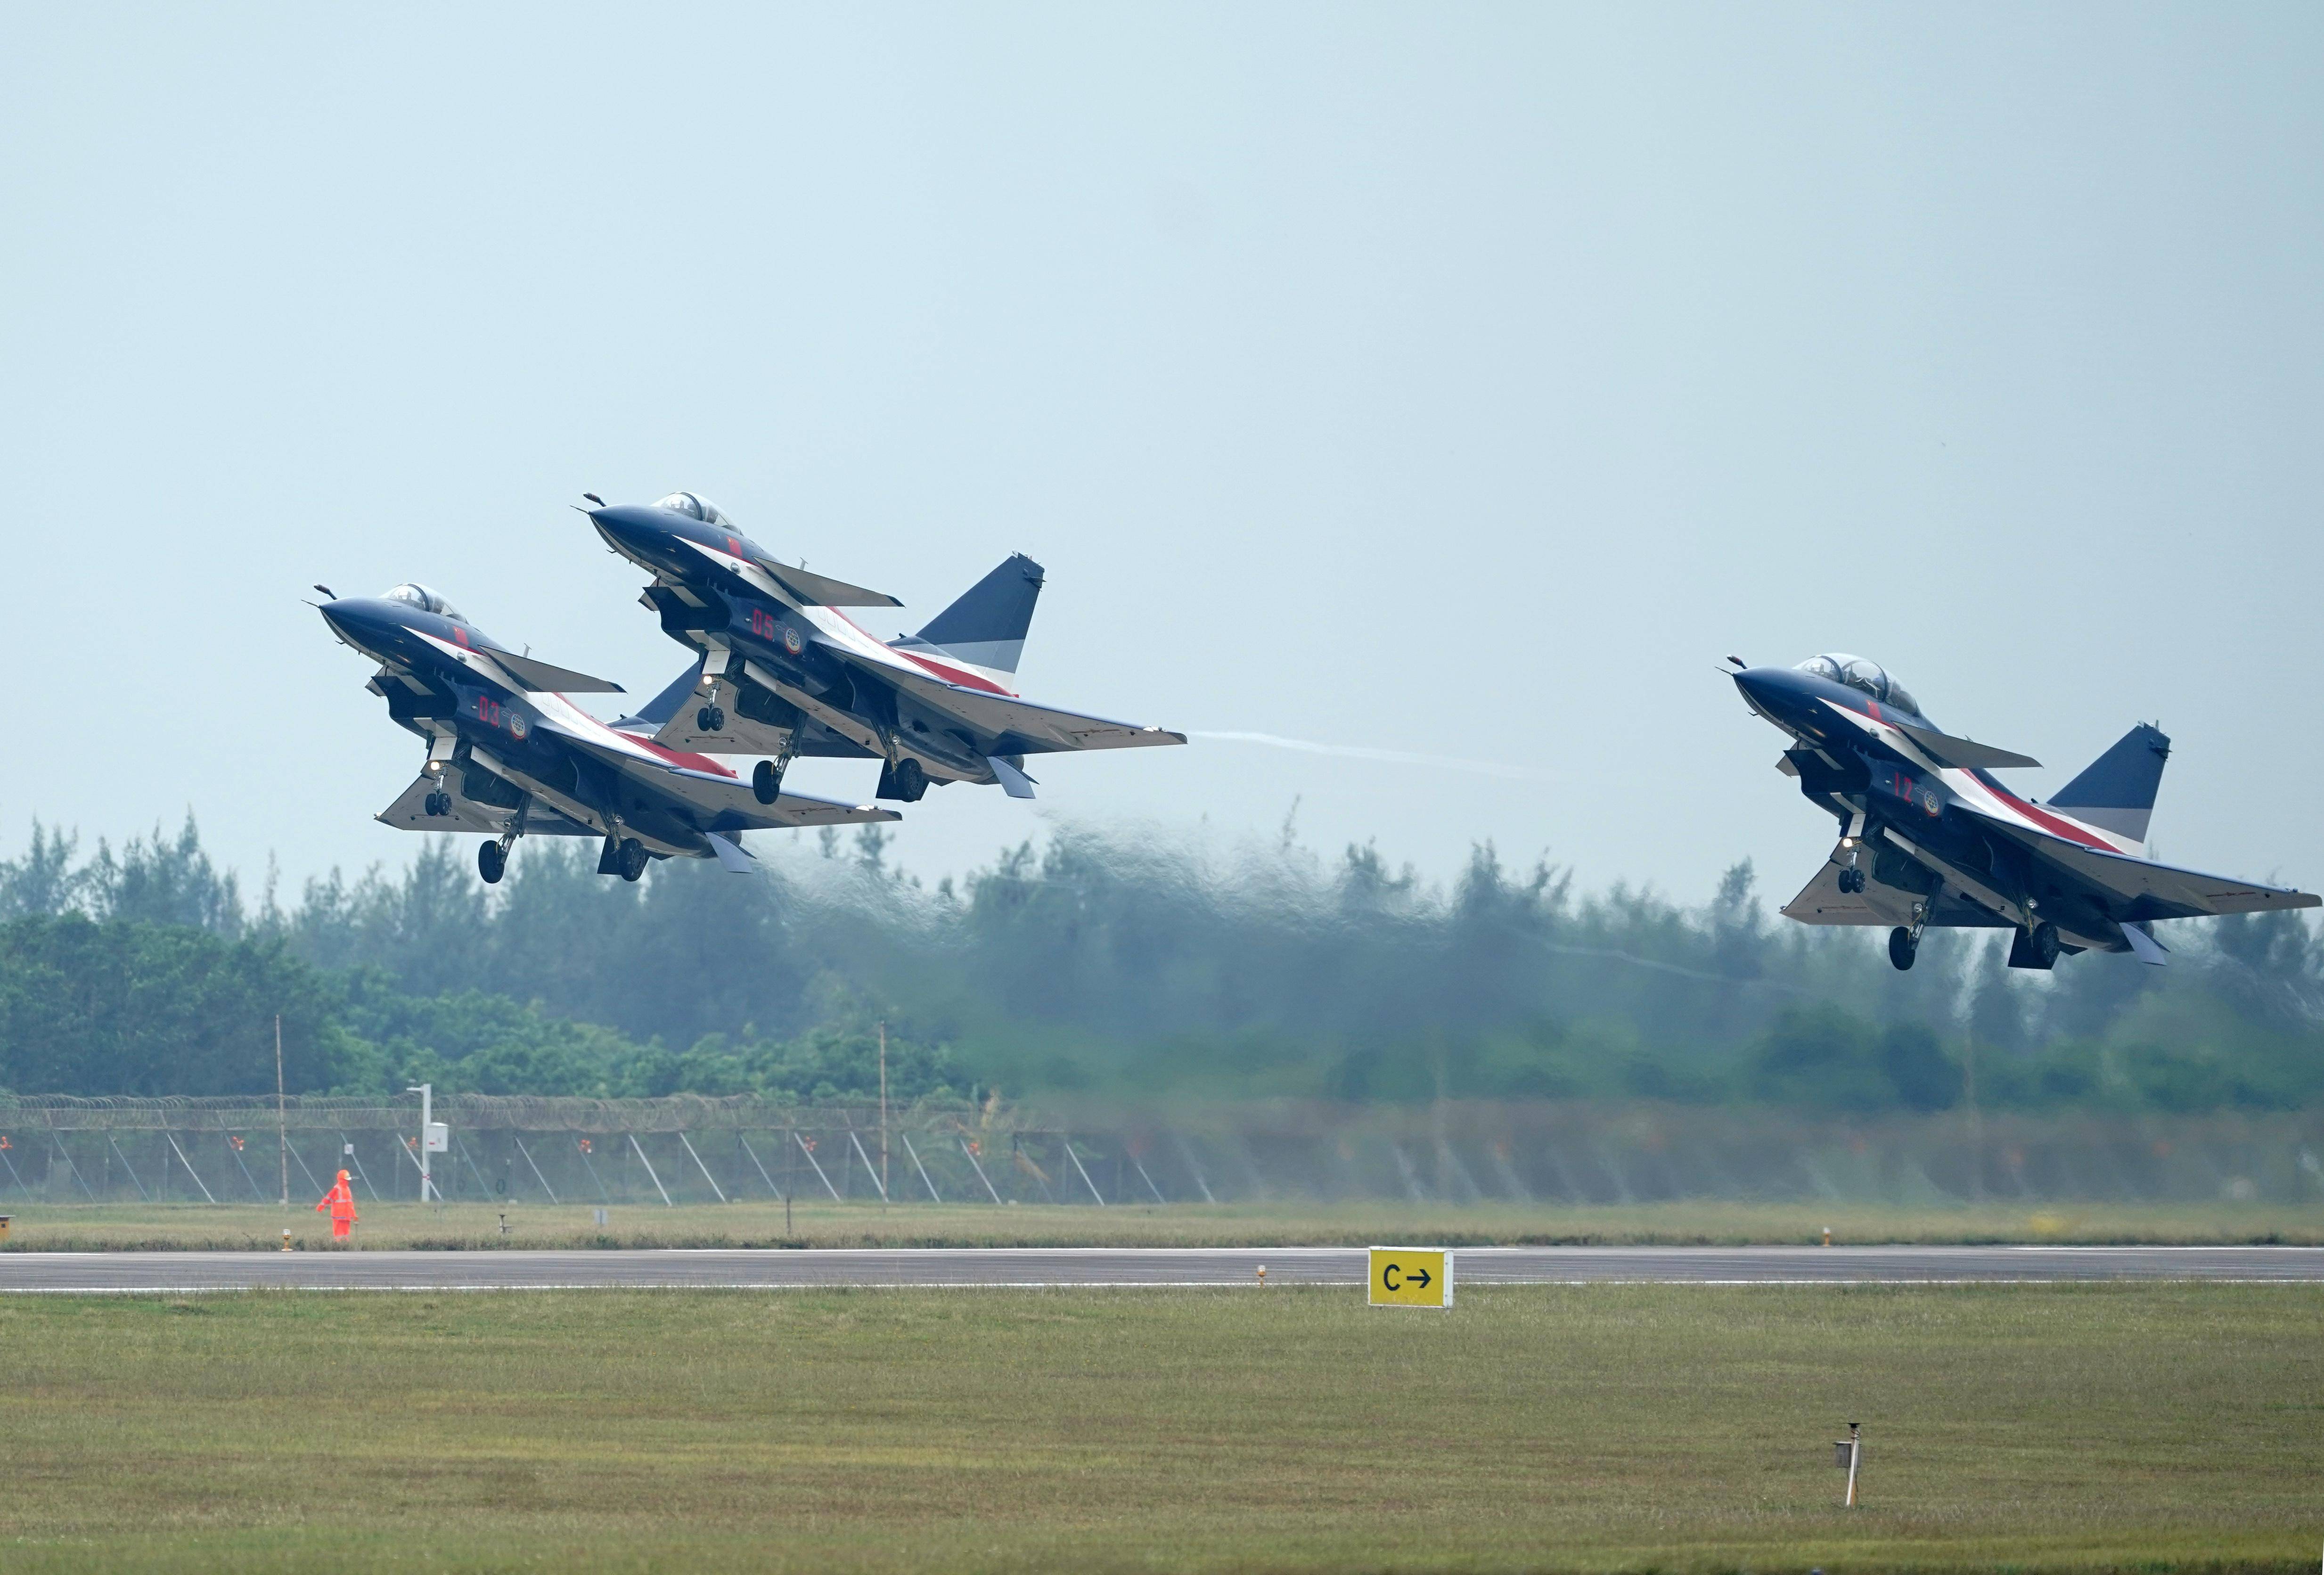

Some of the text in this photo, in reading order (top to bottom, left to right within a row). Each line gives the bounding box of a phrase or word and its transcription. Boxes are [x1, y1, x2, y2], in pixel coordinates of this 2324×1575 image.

[753, 608, 773, 640] 05
[479, 696, 499, 727] 03
[1895, 772, 1912, 803] 12
[1383, 1264, 1400, 1291] C
